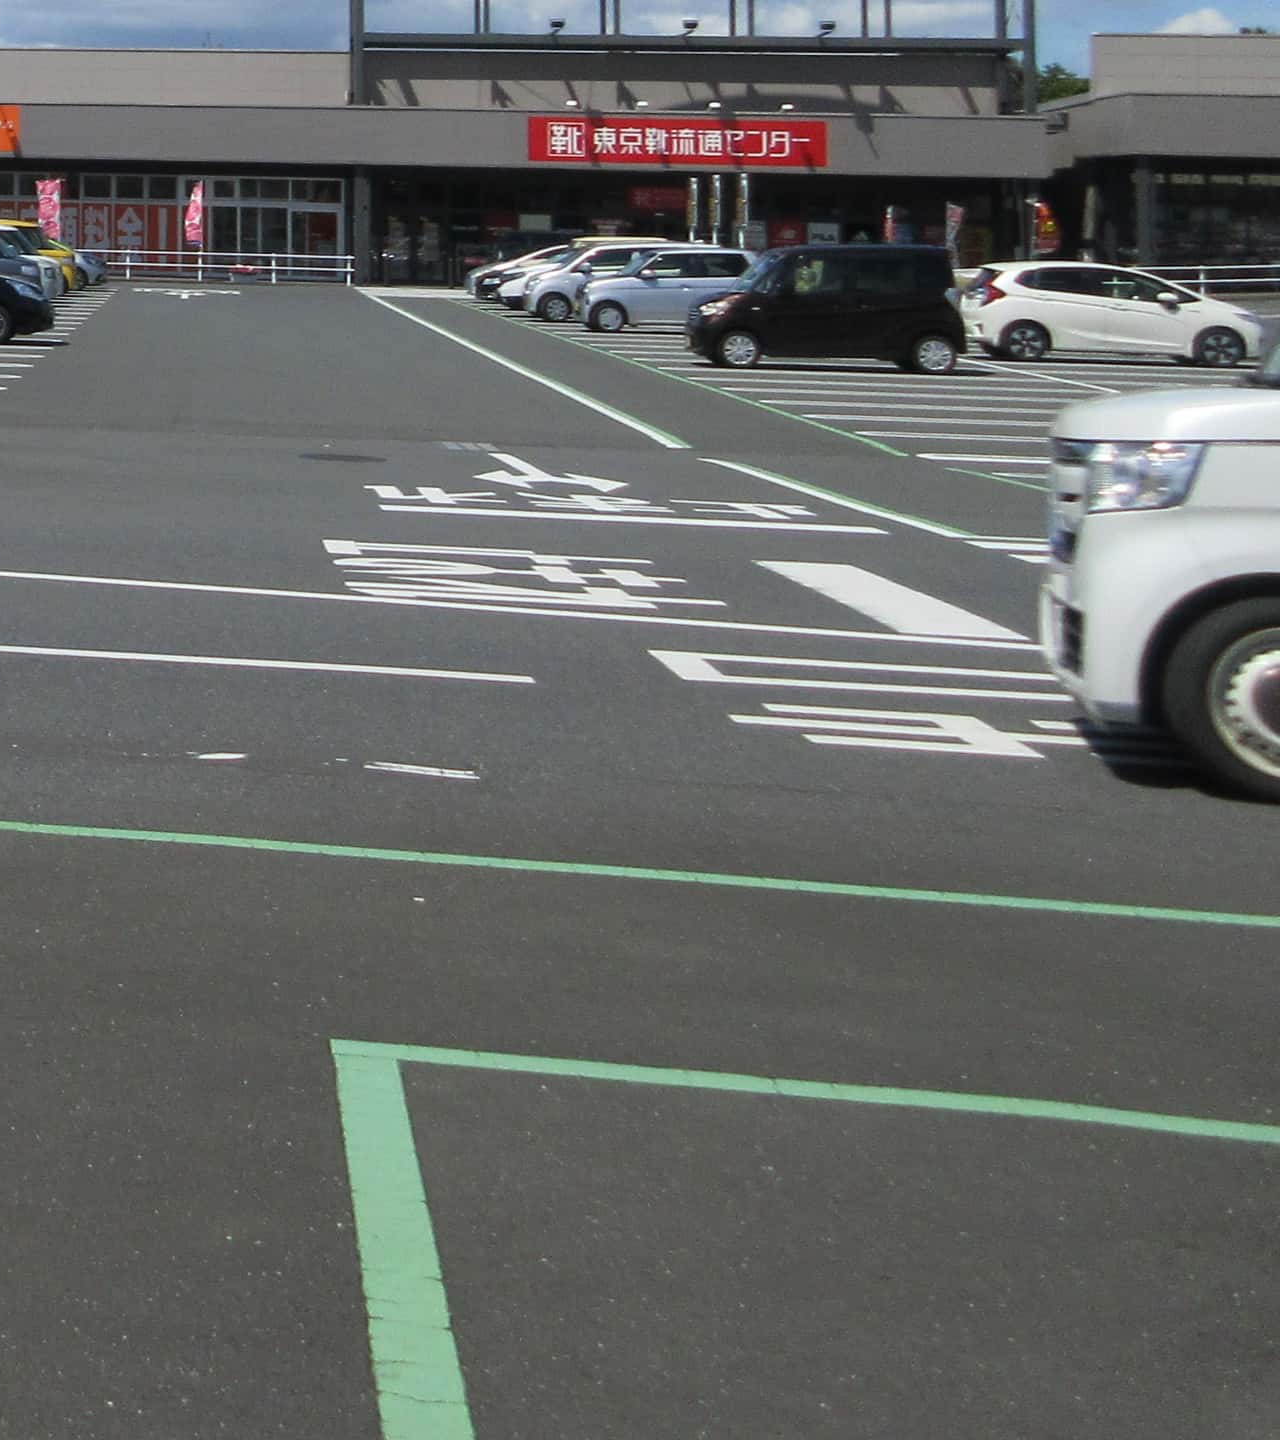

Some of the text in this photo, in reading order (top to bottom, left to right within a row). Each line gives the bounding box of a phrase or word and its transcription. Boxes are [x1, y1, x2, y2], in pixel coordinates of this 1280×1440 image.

[592, 126, 811, 157] 東京靴流通センター
